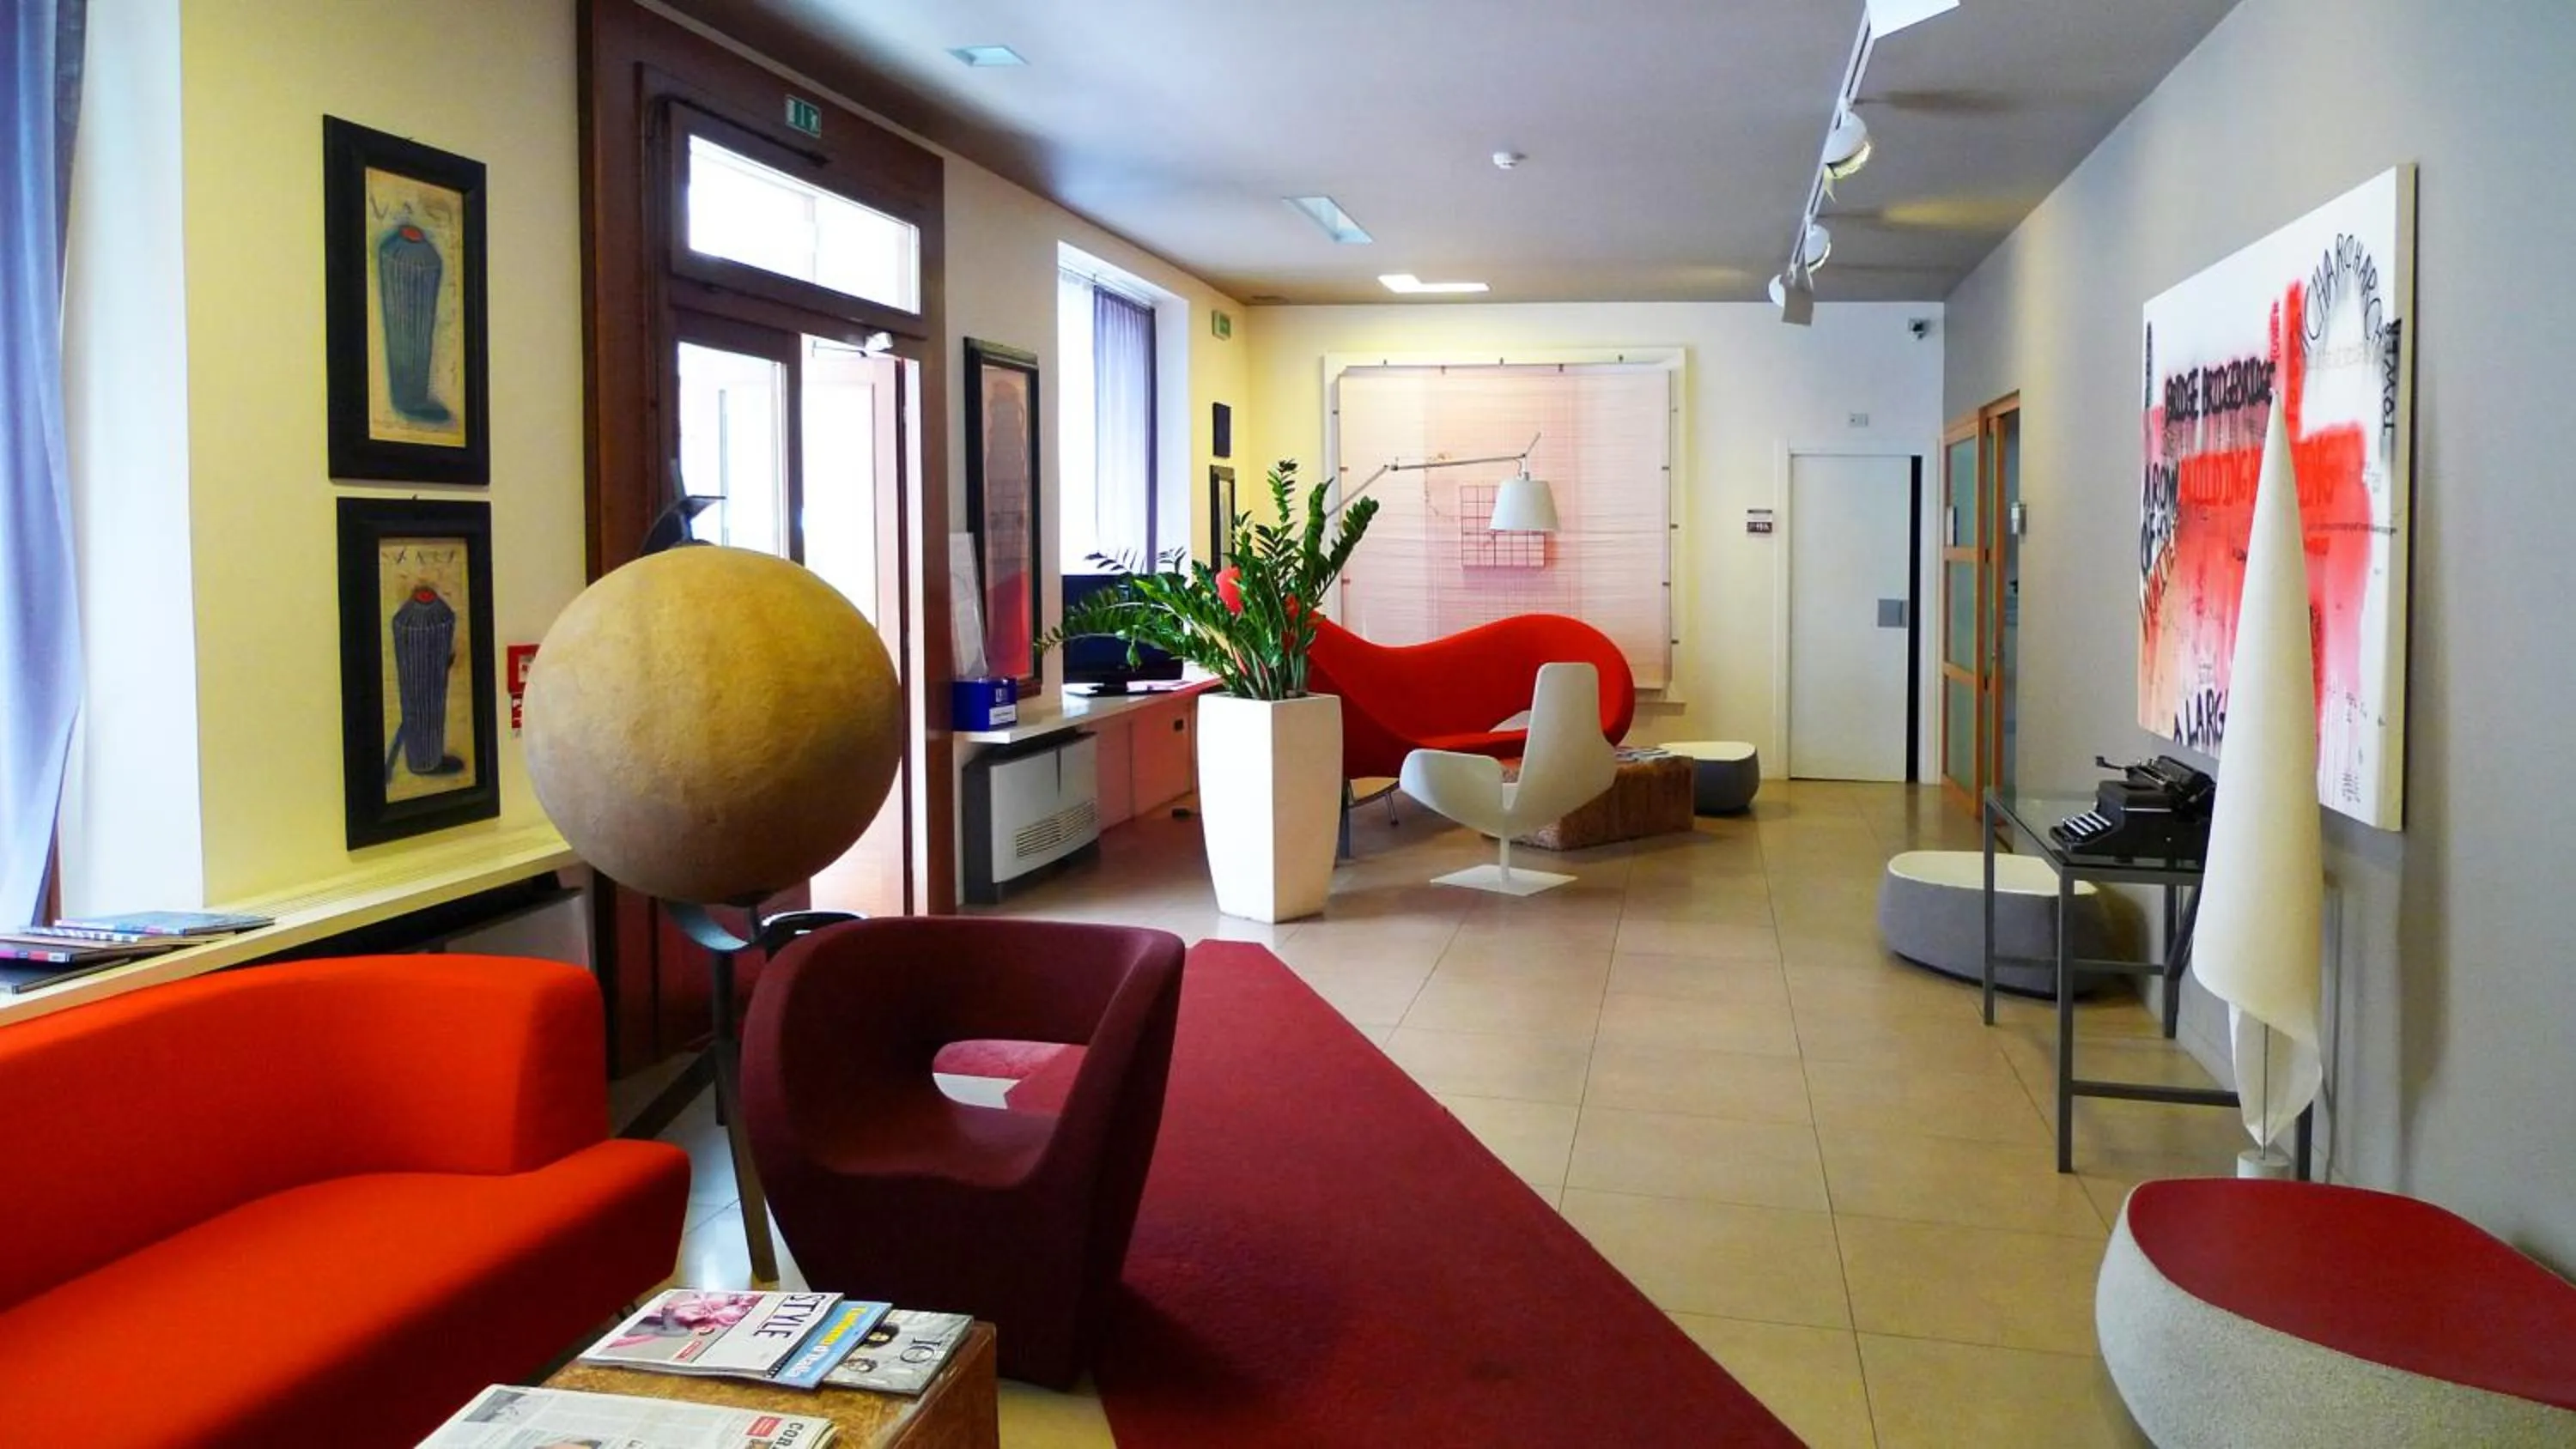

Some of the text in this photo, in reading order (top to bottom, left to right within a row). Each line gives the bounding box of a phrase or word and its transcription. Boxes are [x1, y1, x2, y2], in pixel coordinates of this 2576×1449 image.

[2382, 318, 2402, 436] TOWER
[2185, 688, 2229, 747] LARG
[754, 1294, 826, 1339] STYLE
[769, 1422, 804, 1449] COR
